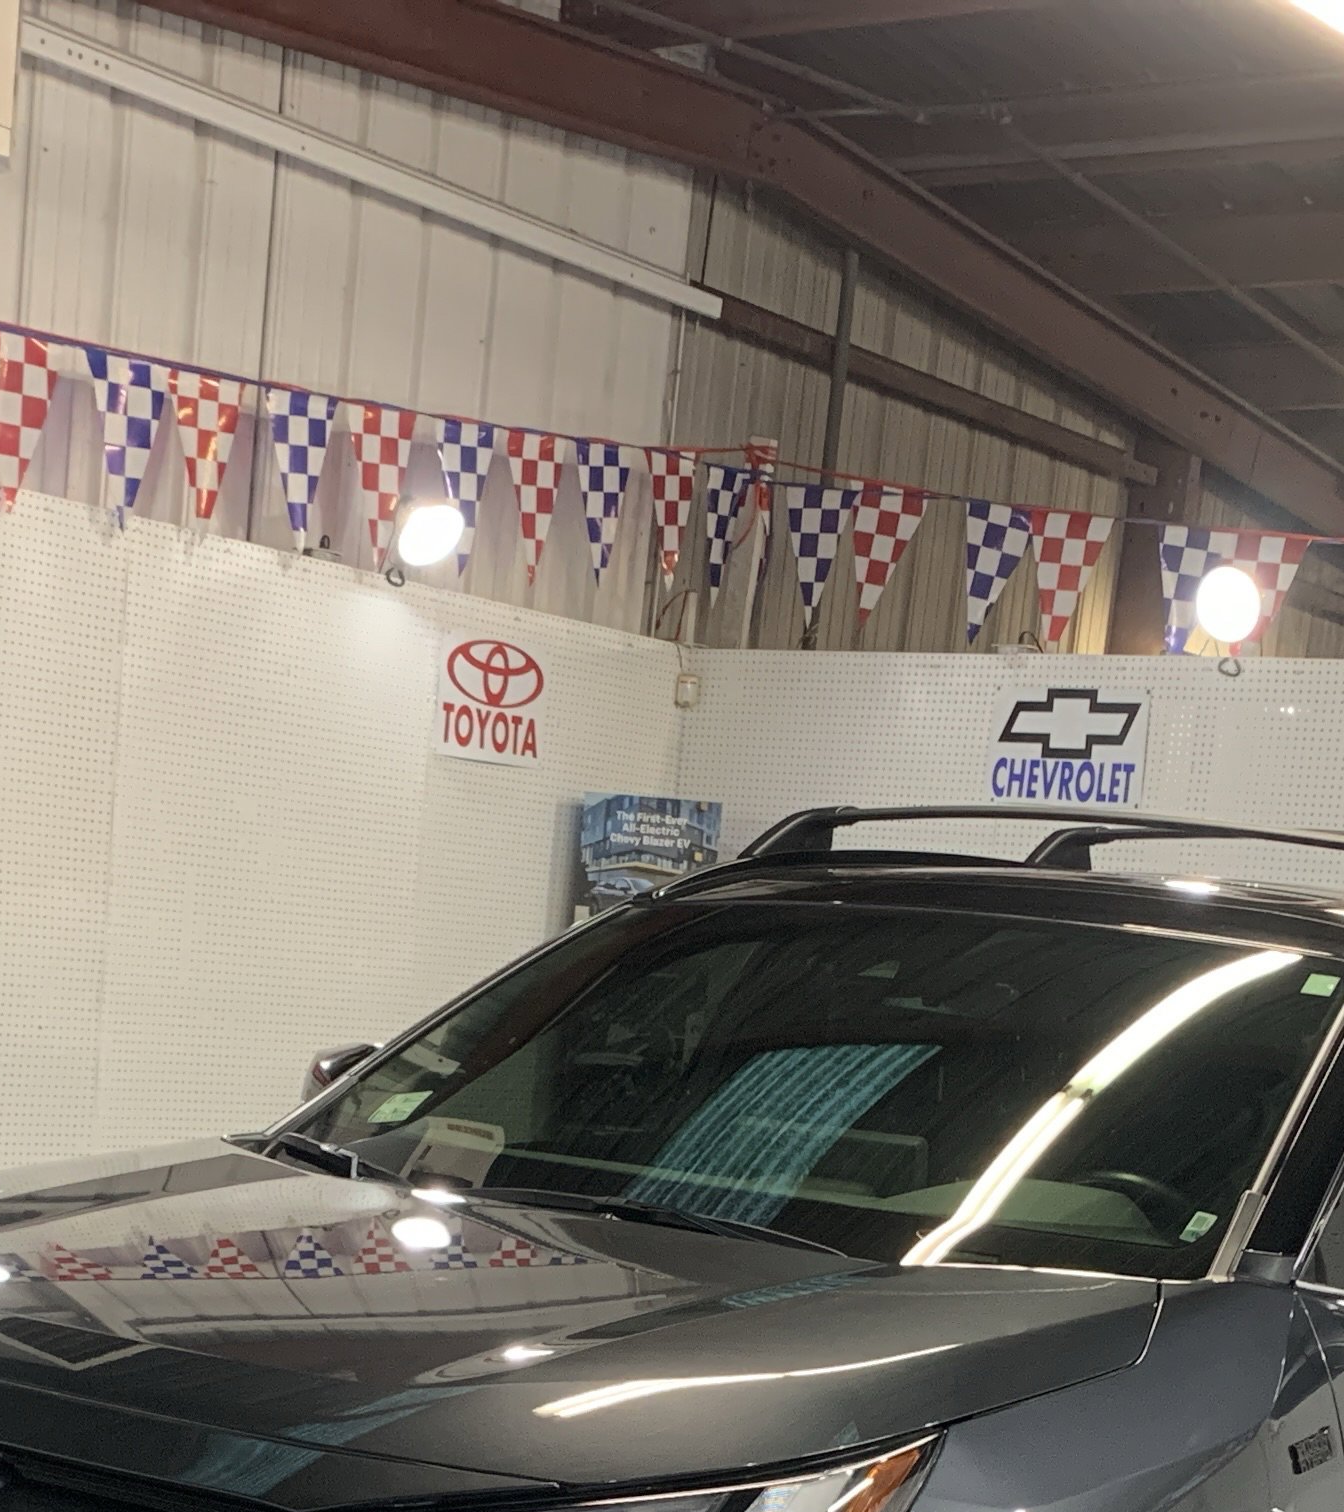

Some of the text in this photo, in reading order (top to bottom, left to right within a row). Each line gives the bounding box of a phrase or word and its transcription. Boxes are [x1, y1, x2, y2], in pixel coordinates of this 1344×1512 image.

[443, 702, 538, 759] TOYOTA
[991, 757, 1136, 804] CHEVROLET
[617, 811, 688, 827] The First-Ever
[623, 823, 680, 836] All-Electric
[610, 833, 641, 847] Chevy
[677, 838, 691, 849] EV
